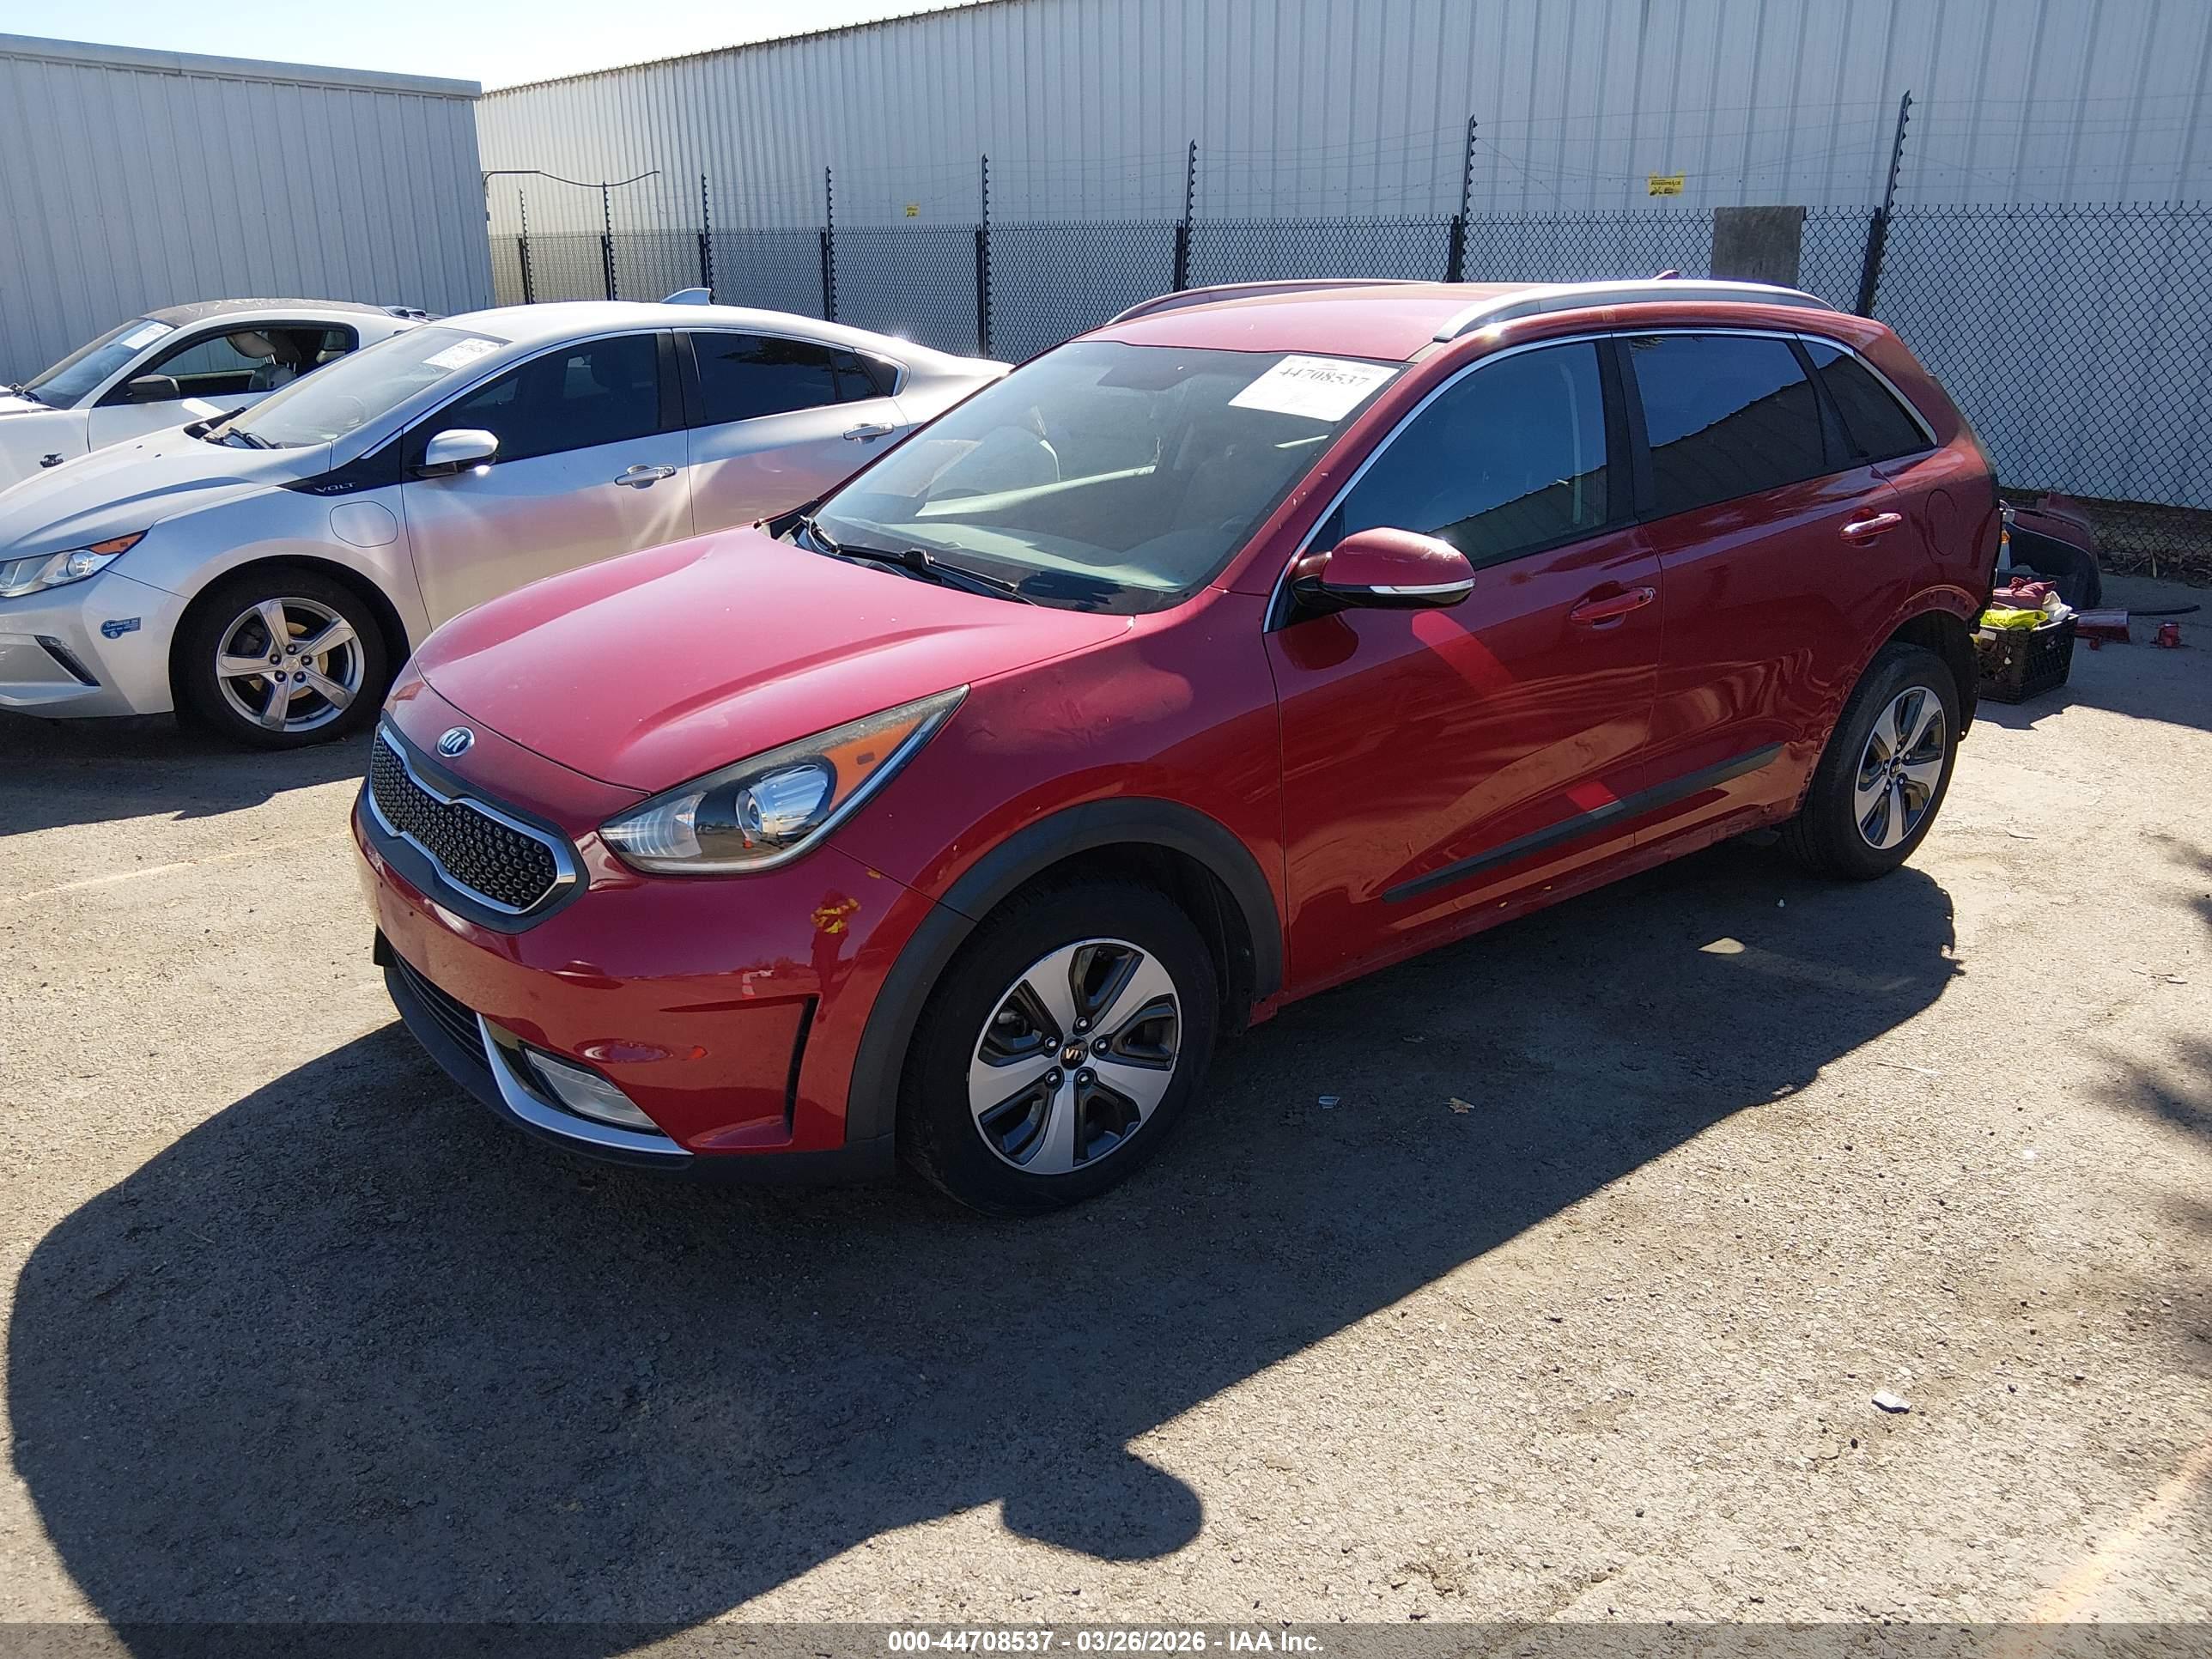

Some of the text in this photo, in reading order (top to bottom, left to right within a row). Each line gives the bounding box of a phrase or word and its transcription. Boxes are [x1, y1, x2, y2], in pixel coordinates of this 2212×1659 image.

[1279, 368, 1370, 386] 44708537
[314, 482, 356, 493] VOLT
[441, 729, 467, 753] KIA
